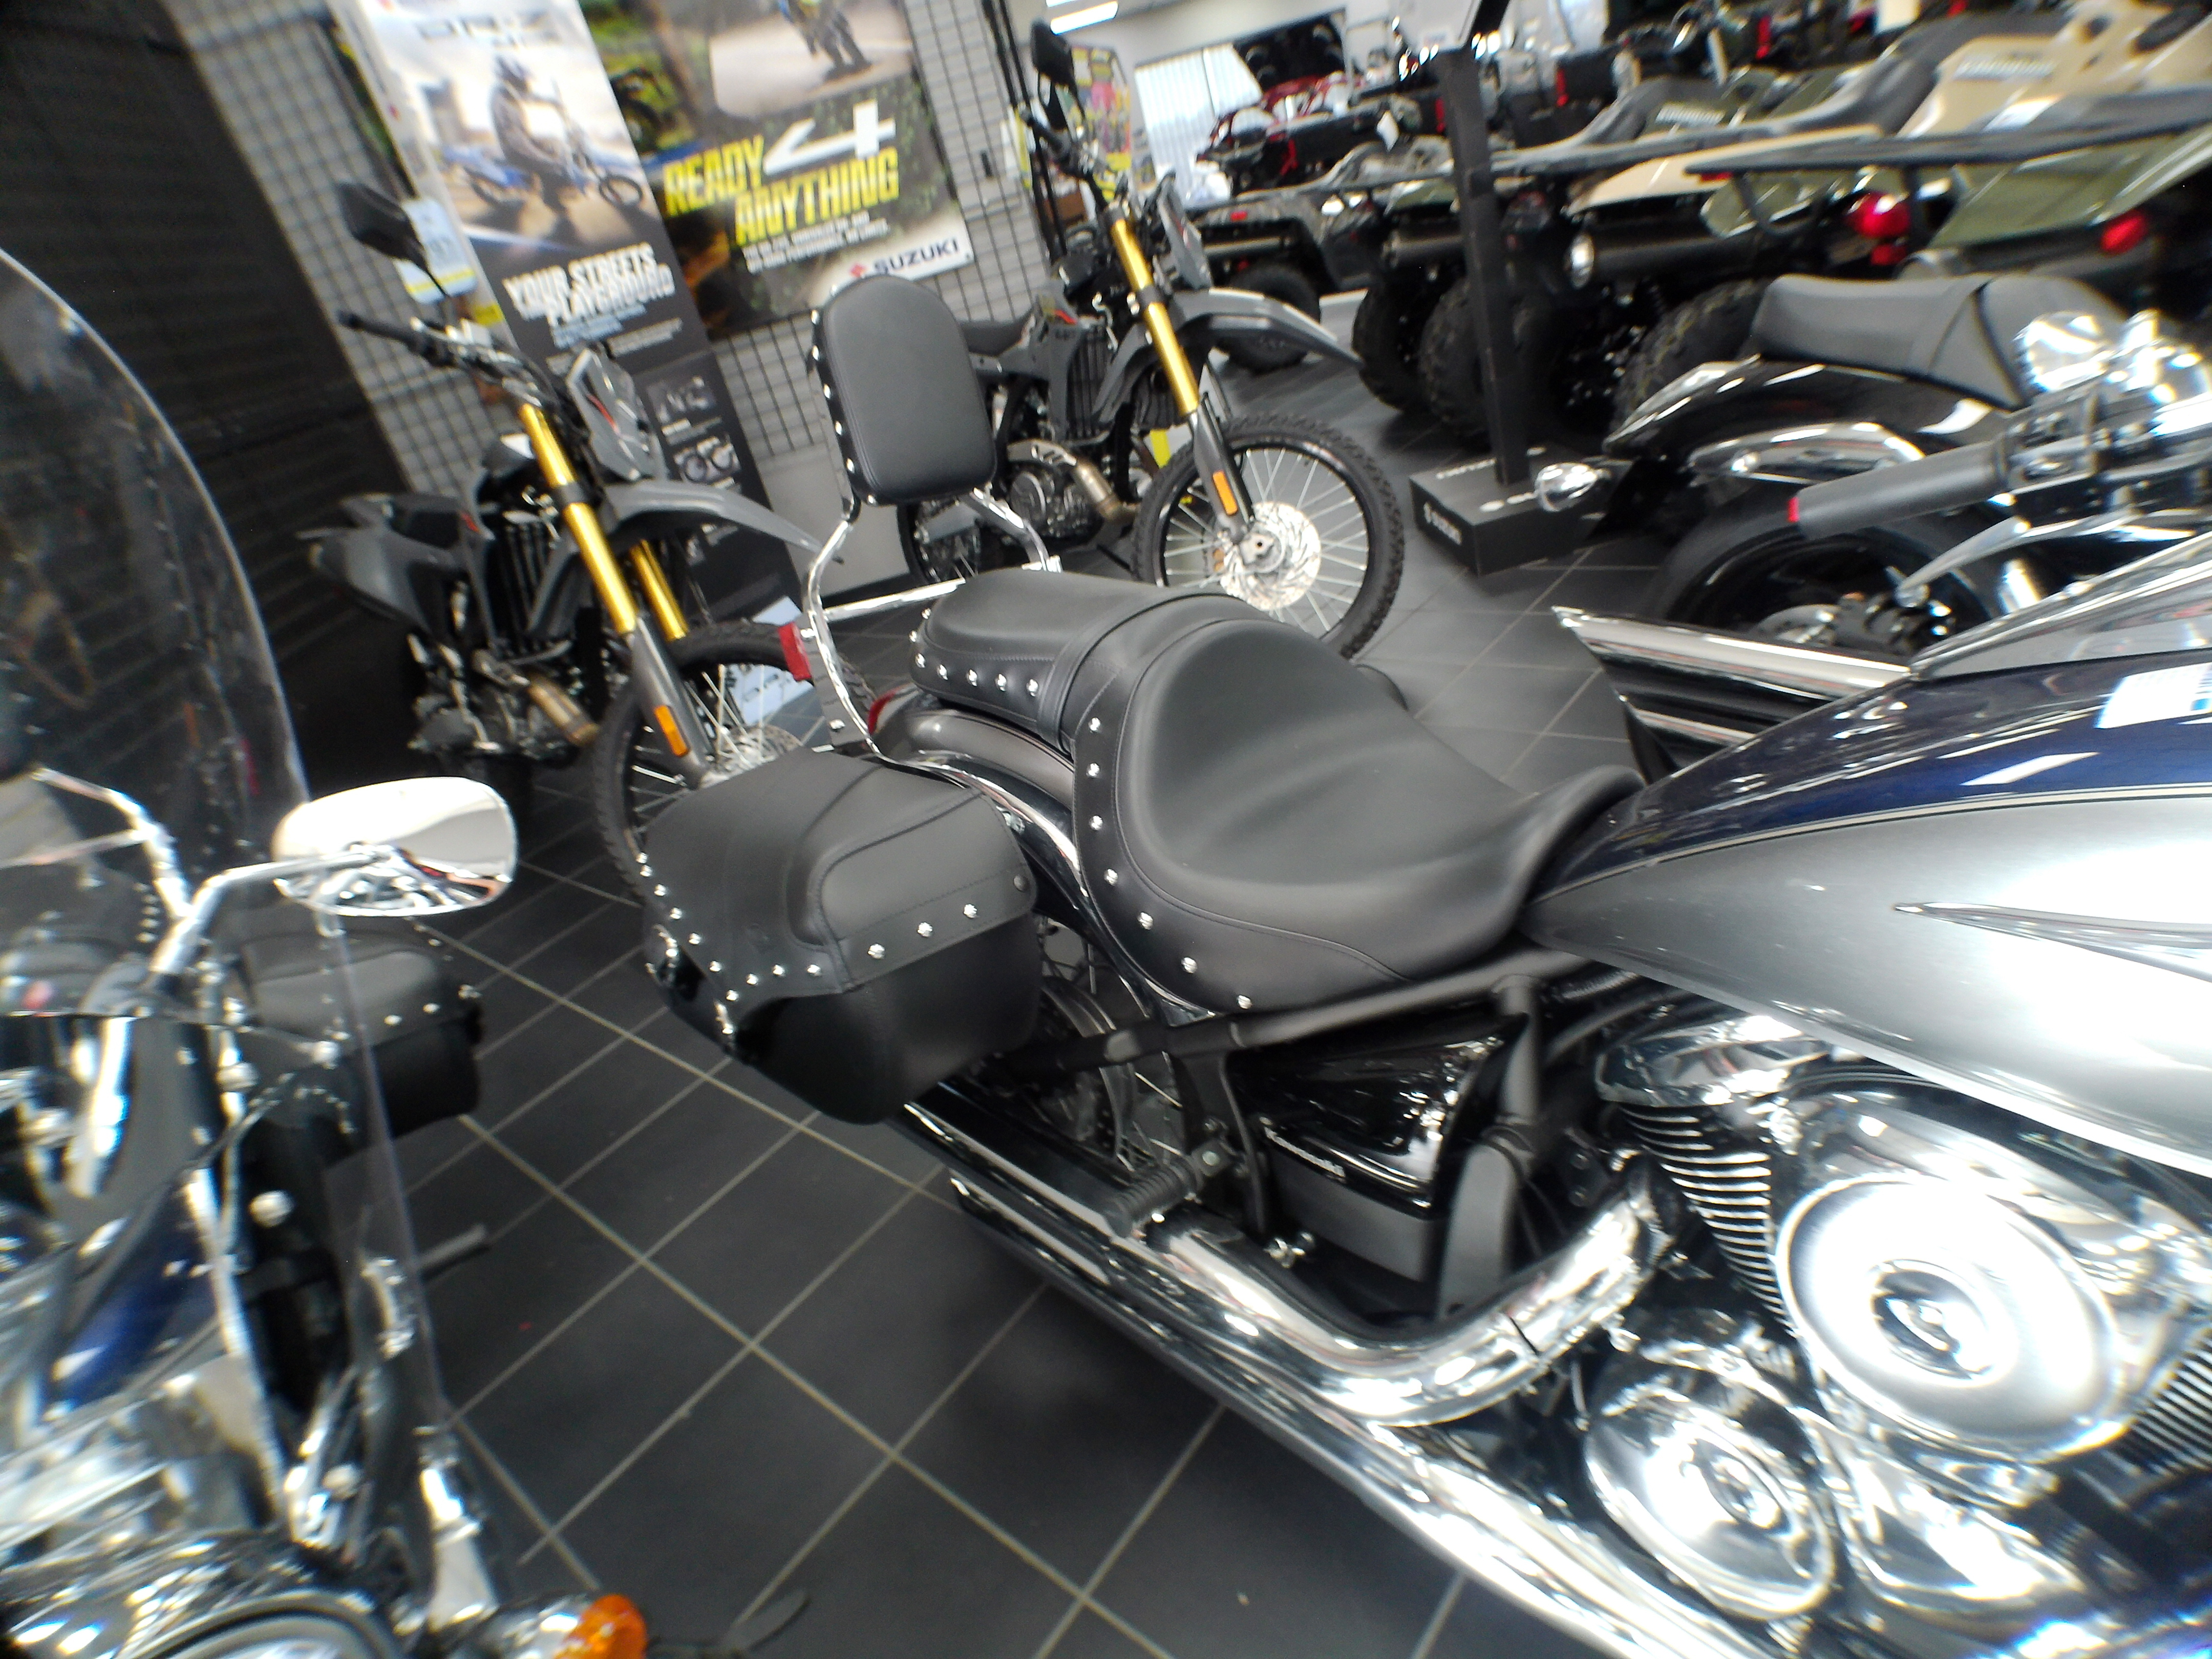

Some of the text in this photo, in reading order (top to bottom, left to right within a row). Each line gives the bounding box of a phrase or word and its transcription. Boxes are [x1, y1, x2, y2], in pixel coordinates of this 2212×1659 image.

[664, 134, 765, 217] READY
[735, 145, 900, 247] ANYTHING
[568, 241, 657, 300] STREETS
[873, 237, 959, 275] SUZUKI
